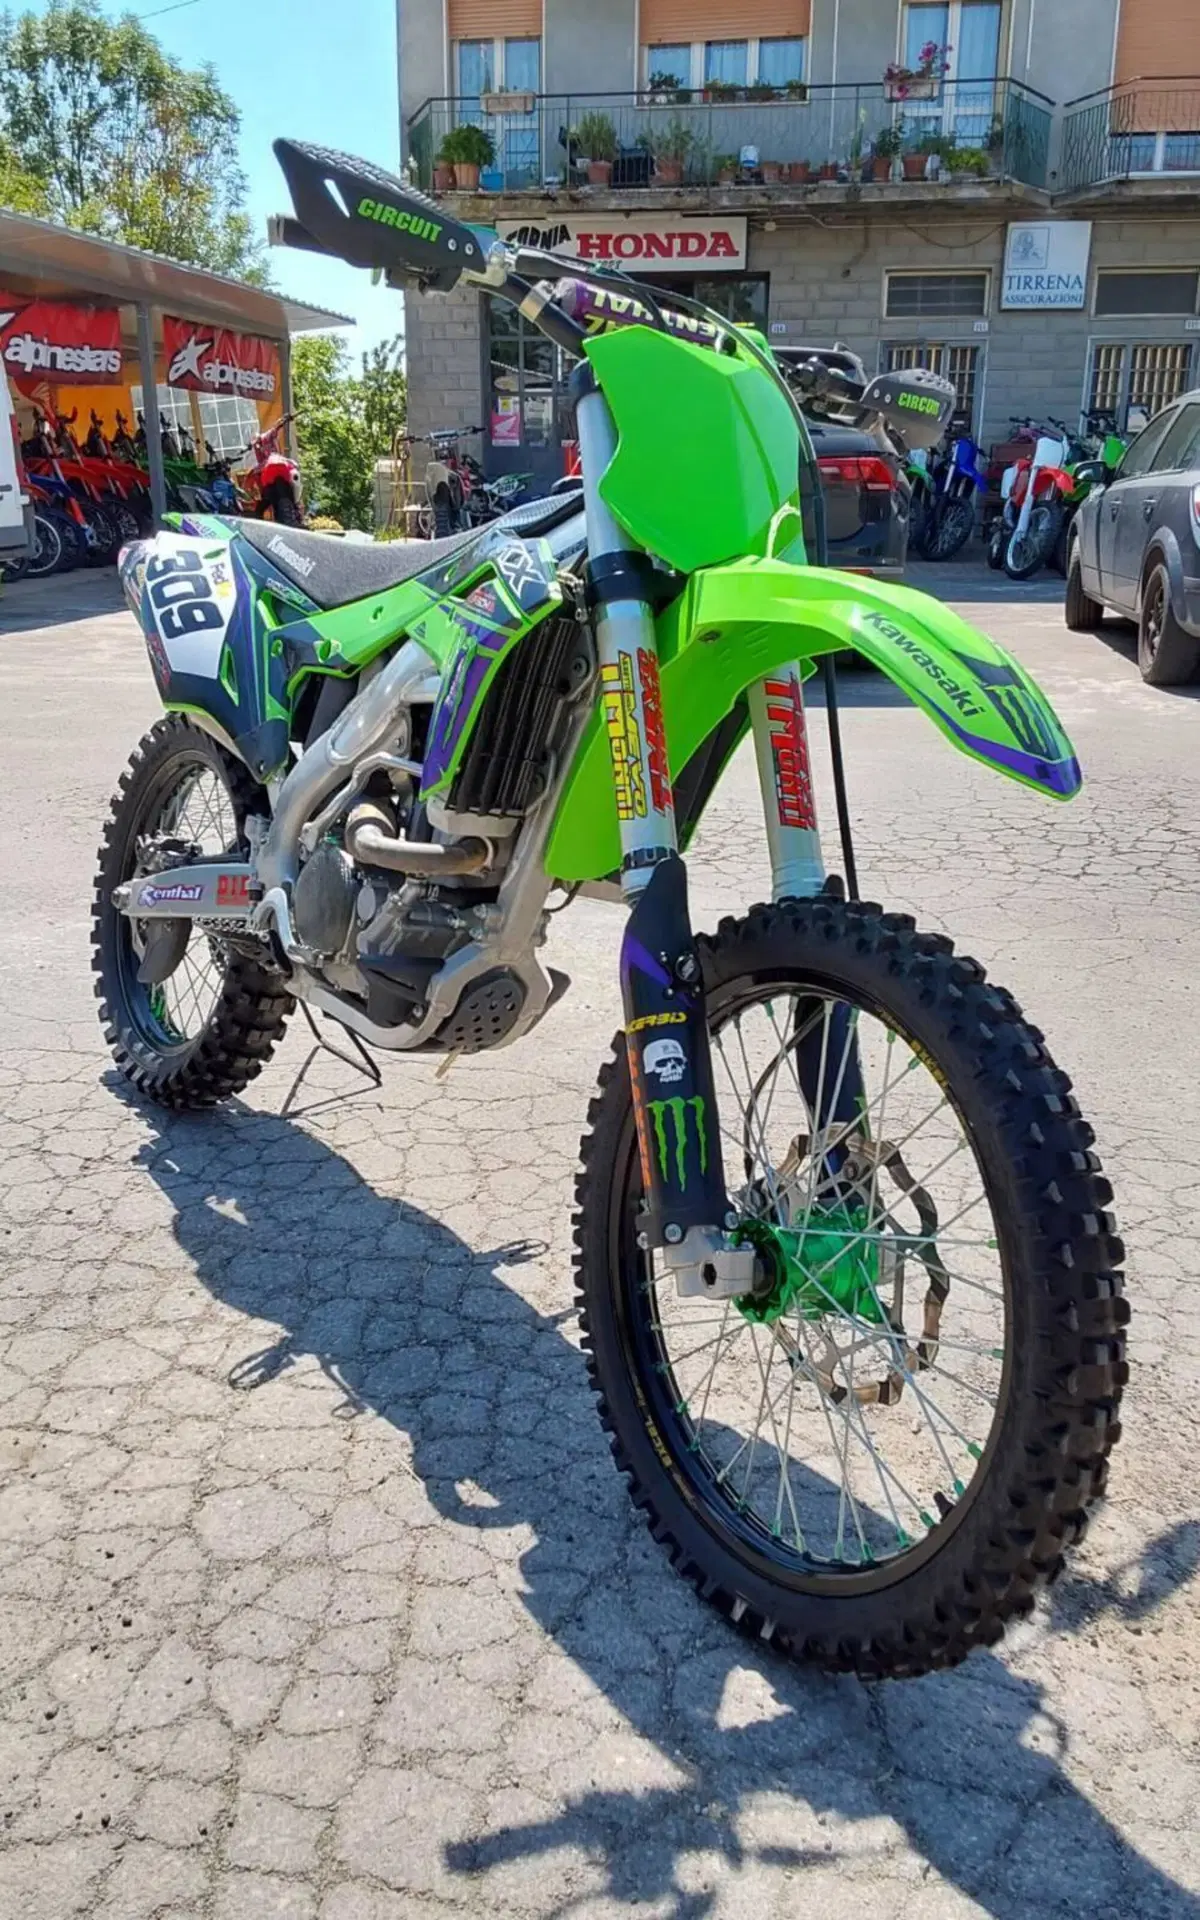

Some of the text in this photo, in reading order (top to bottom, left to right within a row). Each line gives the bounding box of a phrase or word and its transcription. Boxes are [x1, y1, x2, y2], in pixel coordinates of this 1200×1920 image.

[356, 197, 443, 245] CIRCUIT
[576, 232, 740, 259] HONDA
[1005, 273, 1083, 291] TIRRENA
[1005, 292, 1083, 305] ASSICURAZIONI
[4, 333, 122, 374] alpinestars
[202, 358, 276, 393] alpinestars
[148, 549, 225, 639] 309
[863, 610, 987, 718] Kawasaki
[139, 884, 203, 908] Renthal
